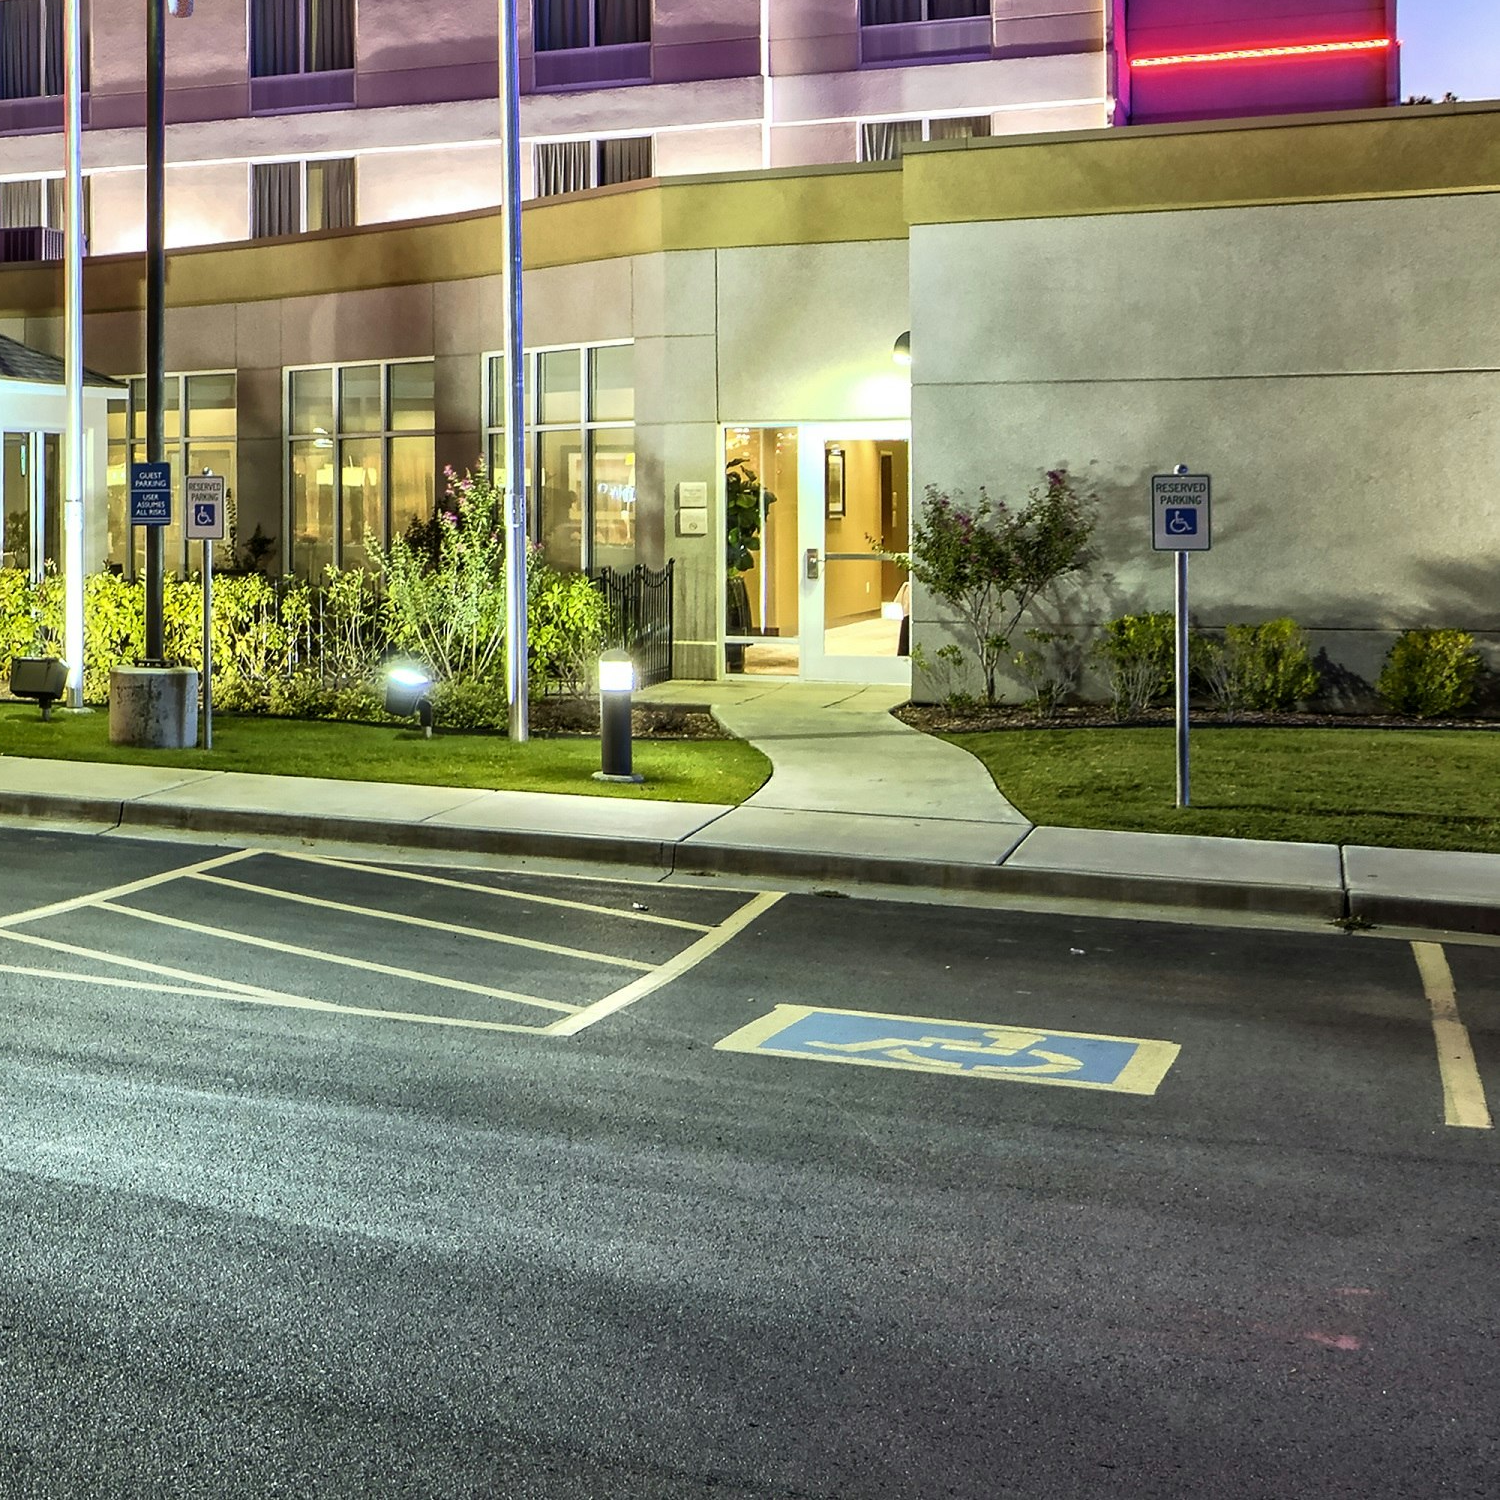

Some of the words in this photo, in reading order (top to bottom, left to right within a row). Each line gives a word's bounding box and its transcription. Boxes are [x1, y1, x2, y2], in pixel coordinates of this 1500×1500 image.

[188, 482, 221, 491] RESERVED
[1155, 483, 1206, 493] RESERVED
[191, 493, 219, 501] PARKING
[1160, 495, 1202, 505] PARKING
